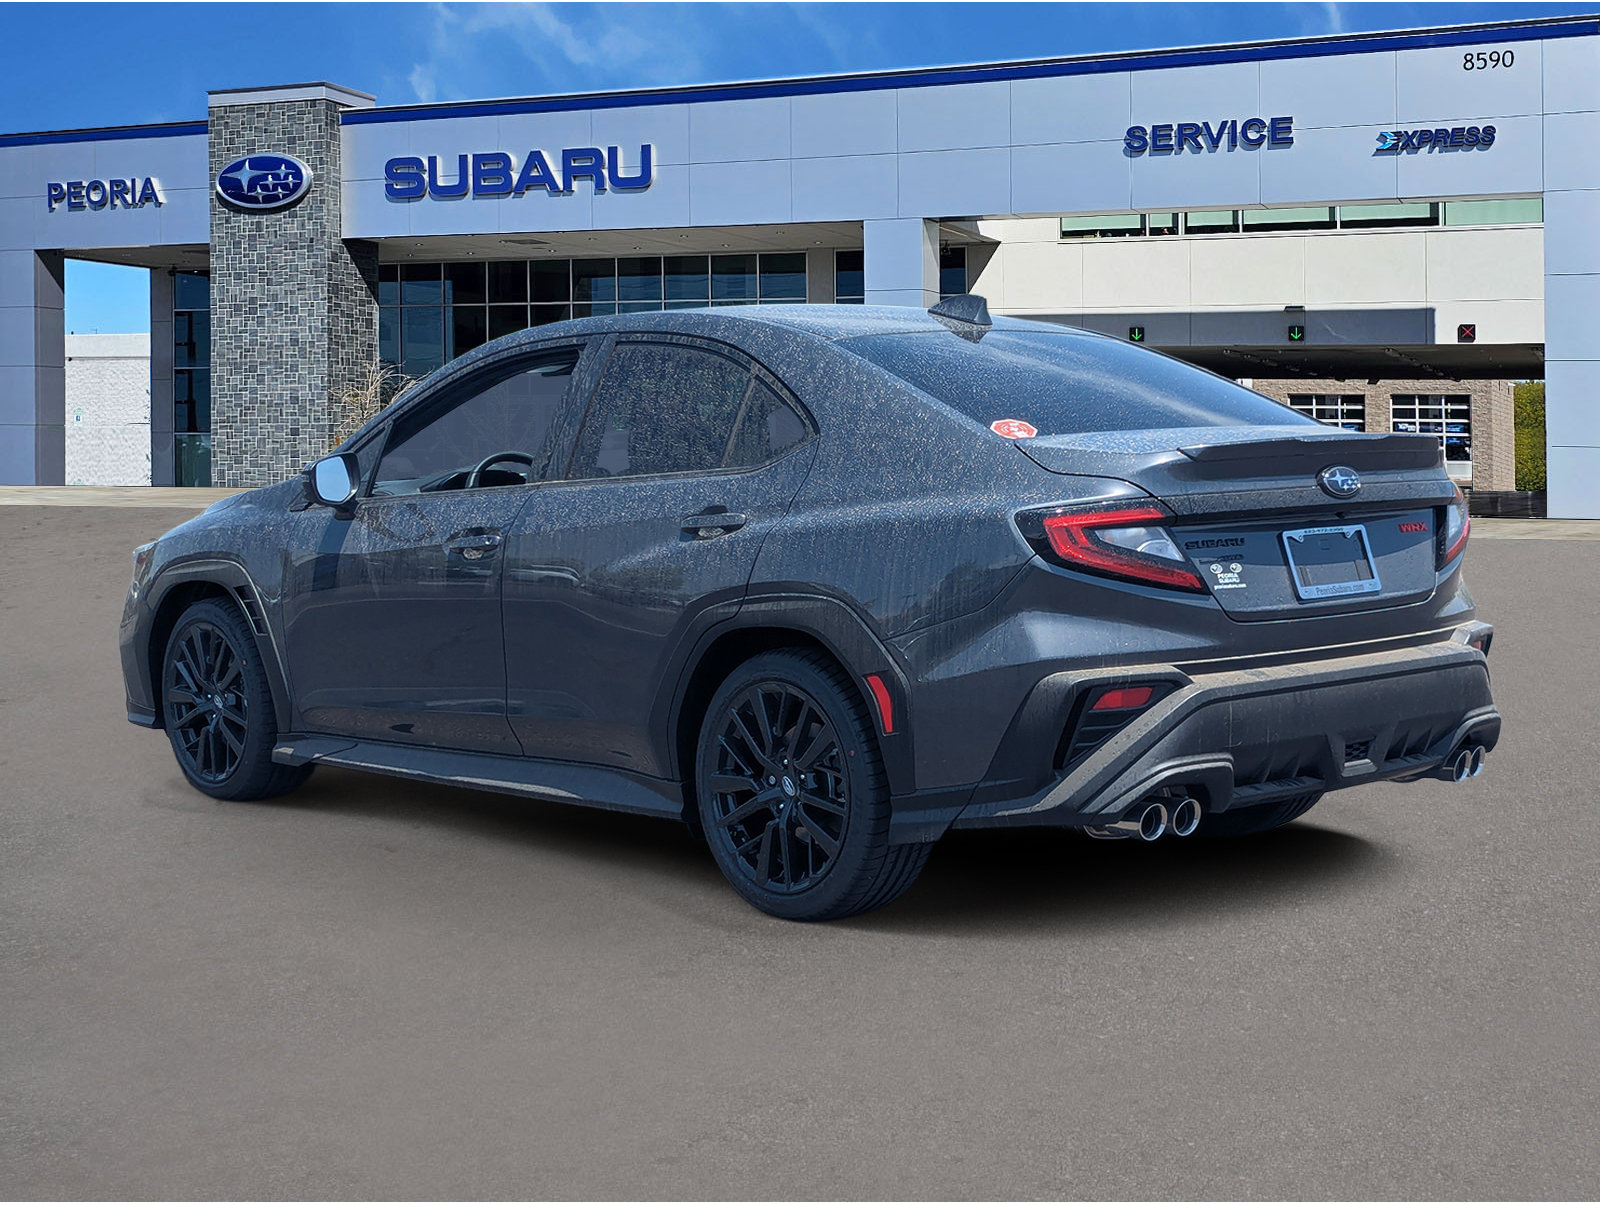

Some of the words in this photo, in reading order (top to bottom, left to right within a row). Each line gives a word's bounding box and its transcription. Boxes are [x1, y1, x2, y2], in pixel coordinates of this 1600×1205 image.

[1463, 50, 1514, 71] 8590
[1125, 116, 1294, 154] SERVICE
[1376, 125, 1497, 151] EXPRESS
[384, 144, 652, 199] SUBARU
[47, 177, 161, 209] PEORIA
[1399, 521, 1428, 533] WRX
[1185, 537, 1245, 550] SUBARU
